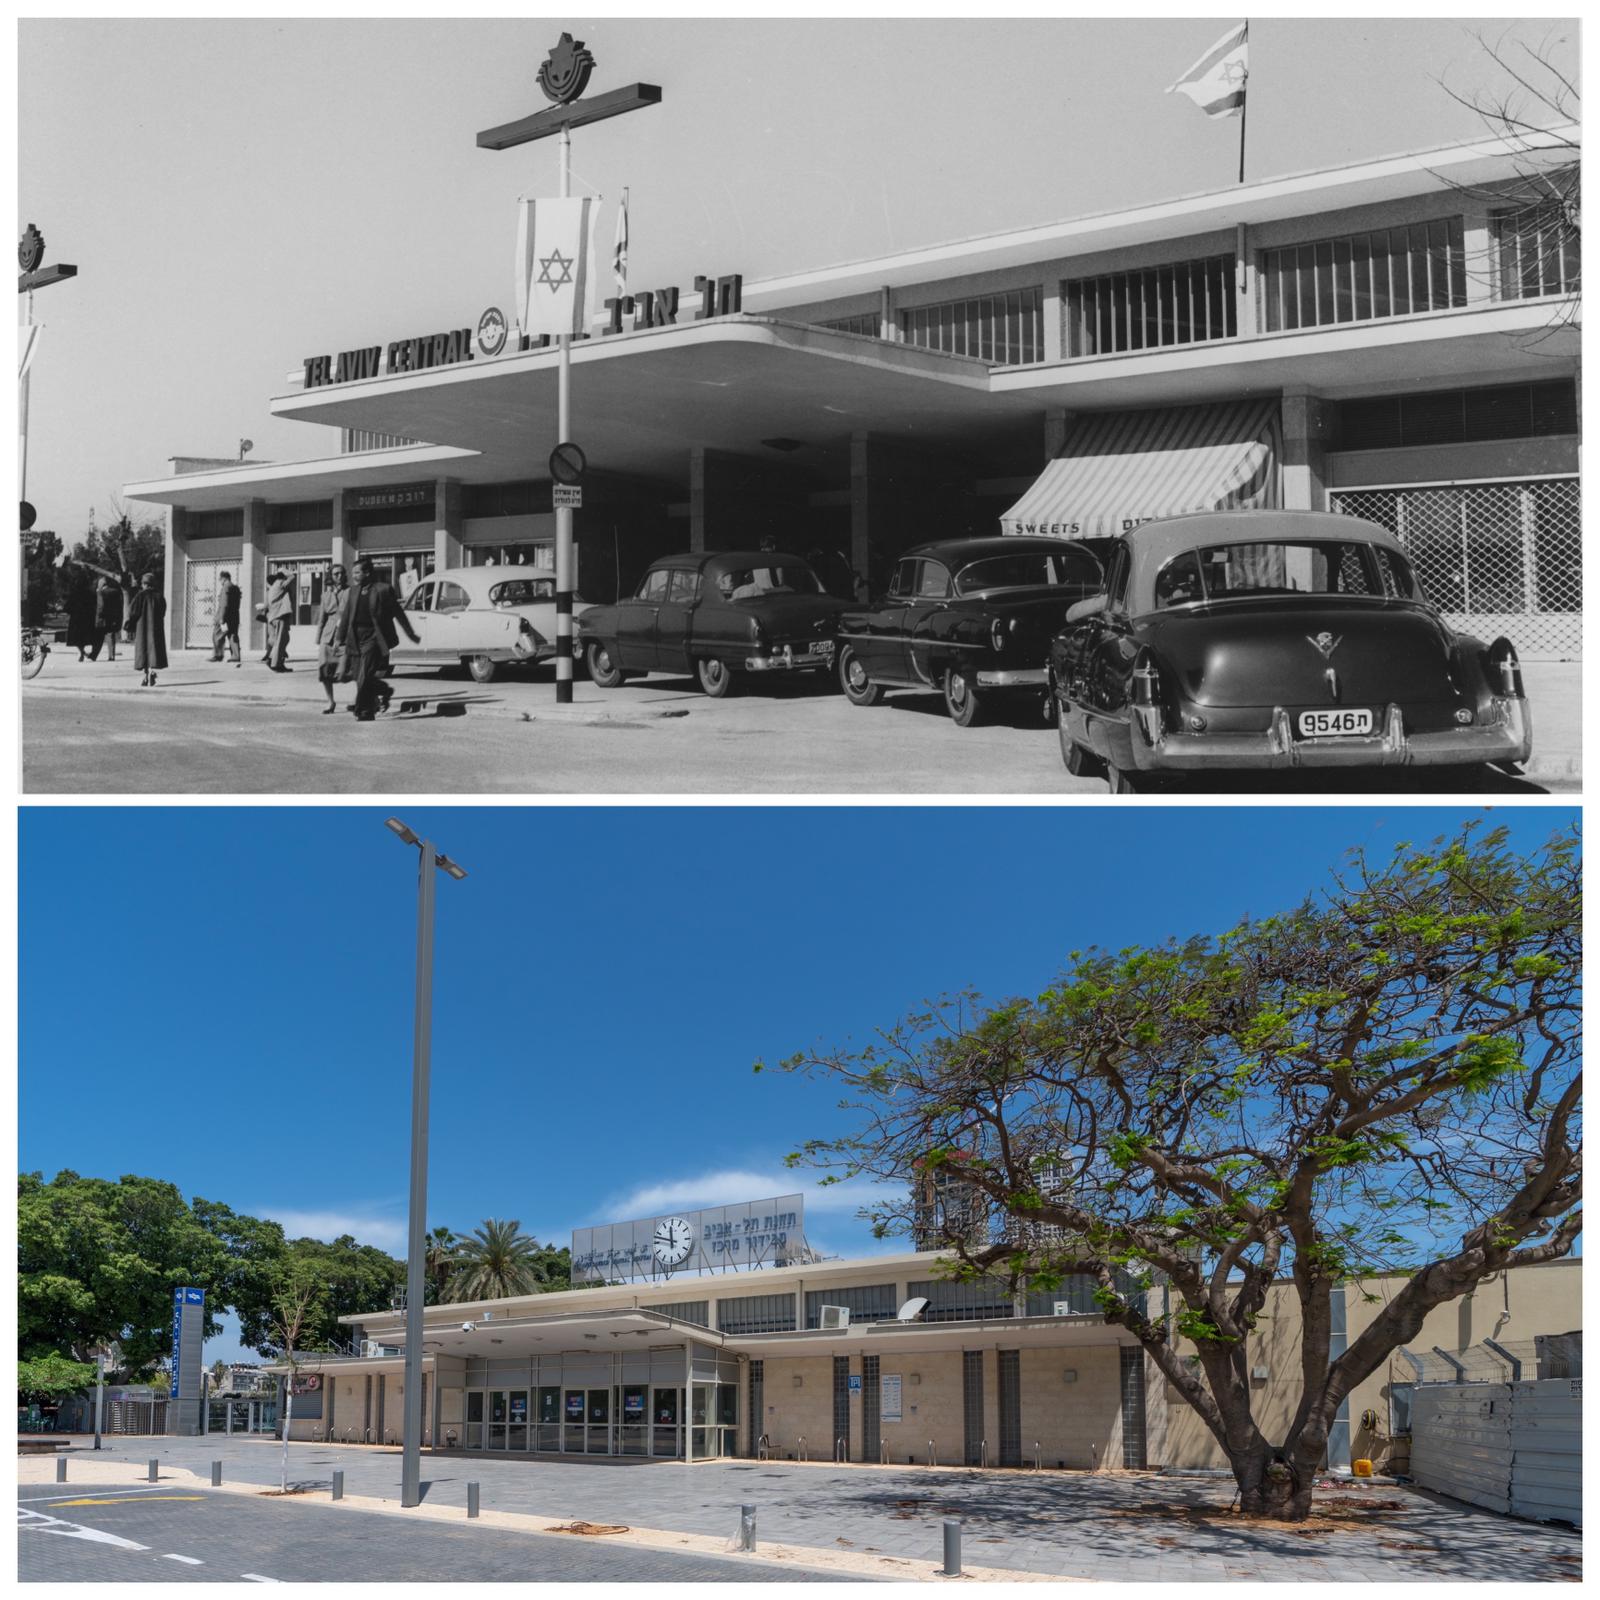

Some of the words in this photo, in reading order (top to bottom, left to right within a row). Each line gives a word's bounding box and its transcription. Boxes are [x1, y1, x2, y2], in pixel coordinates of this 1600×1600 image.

[602, 286, 679, 336] אביב
[694, 273, 742, 320] תל
[303, 355, 333, 389] TEL
[334, 345, 382, 384] AVIV
[386, 328, 475, 374] CENTRAL
[1015, 522, 1080, 534] SWEETS
[764, 1212, 796, 1229] תחנת
